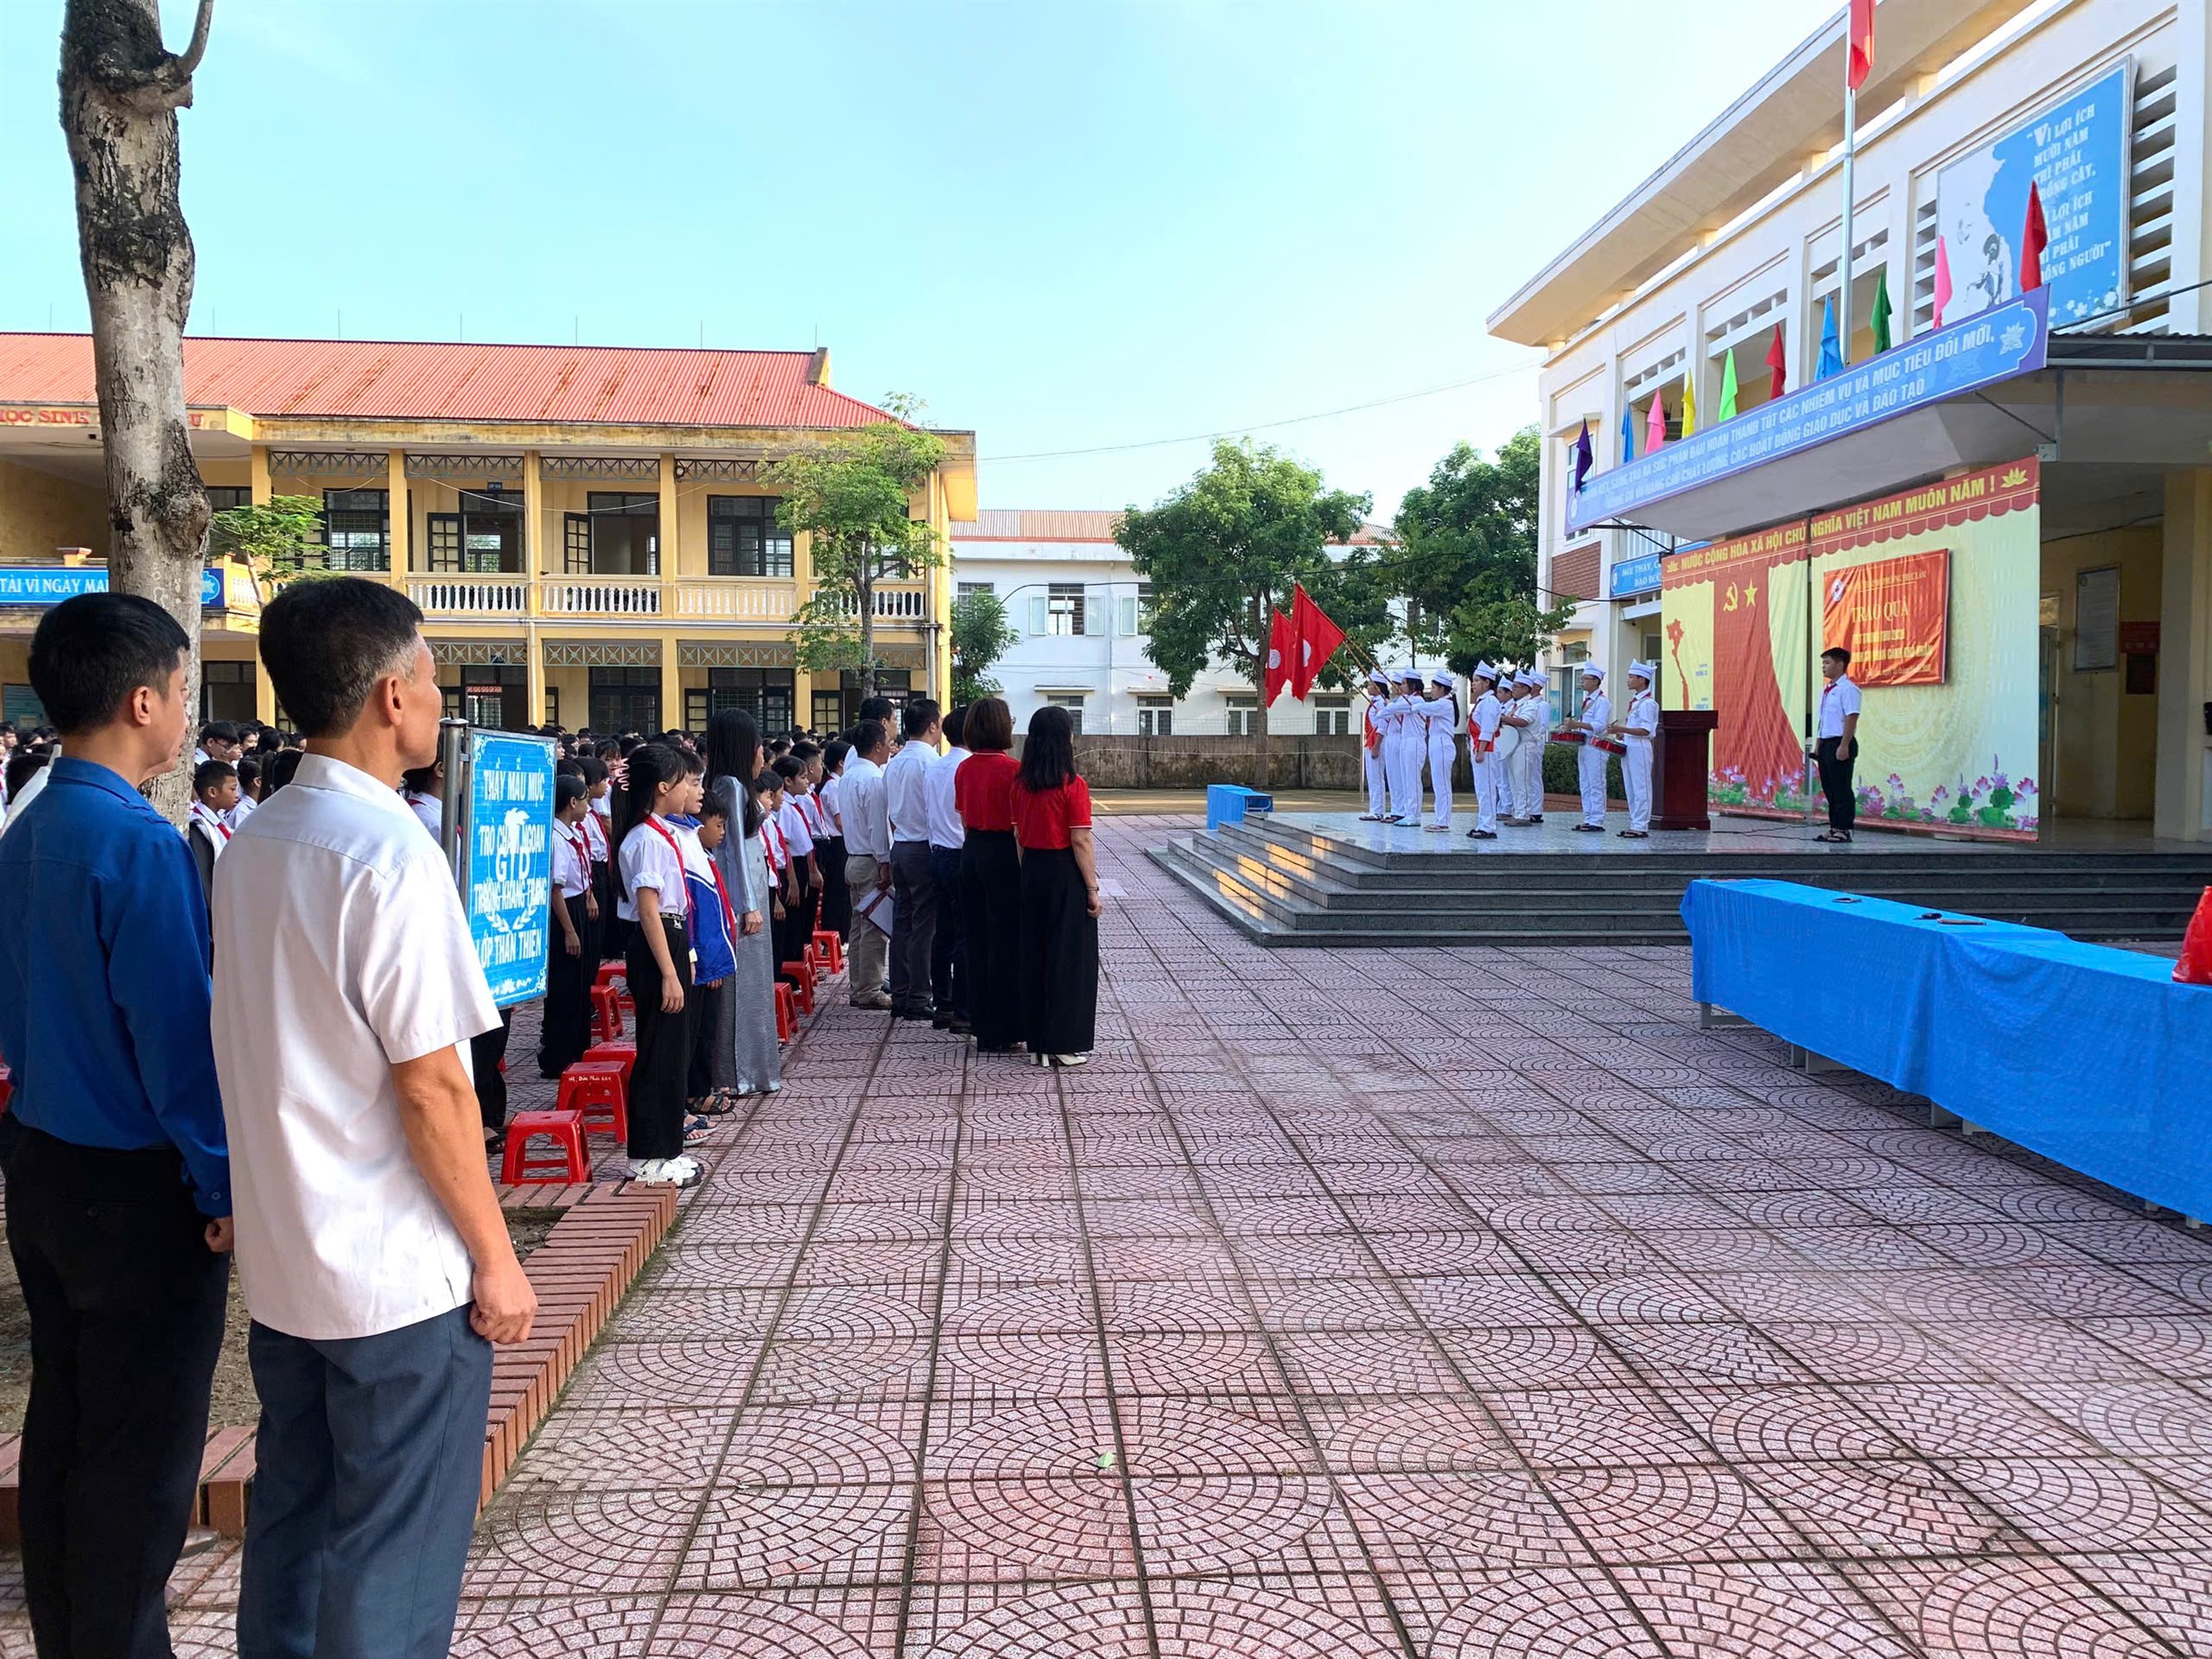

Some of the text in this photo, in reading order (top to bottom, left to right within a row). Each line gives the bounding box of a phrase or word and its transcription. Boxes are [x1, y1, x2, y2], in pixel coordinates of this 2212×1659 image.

[2055, 118, 2072, 138] LỢI
[2075, 103, 2094, 126] ÍCH
[2033, 143, 2062, 168] MƯỜI
[2055, 149, 2081, 175] PHẢI
[2052, 202, 2070, 222] LỢI
[2074, 191, 2093, 212] ÍCH
[2052, 235, 2079, 259] PHẢI
[1732, 418, 1759, 442] THÀNH
[1761, 411, 1777, 431] TỐT
[1779, 403, 1799, 424] CÁC
[1802, 389, 1835, 415] NHIỆM
[1838, 382, 1852, 403] VỤ
[1855, 372, 1870, 394] VÀ
[1872, 361, 1900, 385] MỤC
[1904, 347, 1932, 372] TIÊU
[1935, 331, 1958, 361] ĐỔI
[1962, 324, 1995, 352] MỚI,
[39, 410, 90, 424] SINH
[1703, 453, 1729, 474] LƯỢNG
[1731, 445, 1748, 465] CÁC
[1750, 436, 1774, 457] HOẠT
[1775, 426, 1801, 448] ĐỘNG
[1803, 415, 1827, 438] GIÁO
[1830, 407, 1852, 429] DỤC
[1855, 396, 1870, 417] VÀ
[1872, 387, 1897, 412] ĐÀO
[1901, 378, 1925, 404] TẠO
[1681, 554, 1703, 570] NƯỚC
[1705, 546, 1728, 566] CỘNG
[1730, 540, 1749, 559] HÒA
[1751, 536, 1764, 555] XÃ
[1766, 534, 1783, 552] HỘI
[1785, 522, 1806, 544] CHỦ
[1811, 512, 1843, 538] NGHĨA
[1846, 503, 1870, 530] VIỆT
[1872, 499, 1902, 522] NAM
[1905, 488, 1947, 514] MUÔN
[1950, 478, 1985, 503] NĂM
[24, 574, 40, 593] VÌ
[43, 574, 81, 594] NGÀY
[1852, 596, 1910, 623] TRAO QUÀ
[484, 757, 545, 808] THẦY MẪU MỰC
[518, 922, 542, 963] THIỆN
